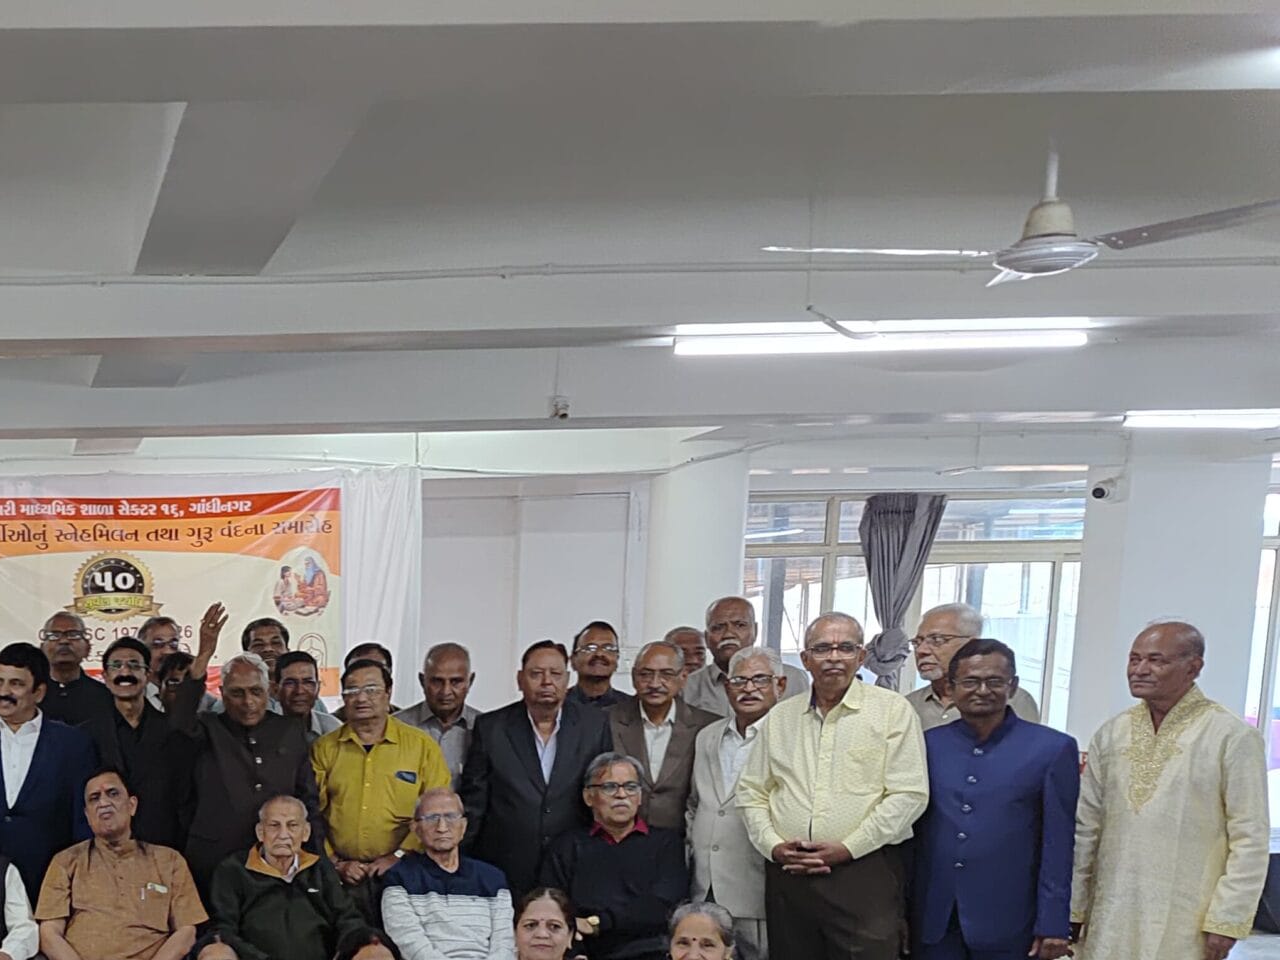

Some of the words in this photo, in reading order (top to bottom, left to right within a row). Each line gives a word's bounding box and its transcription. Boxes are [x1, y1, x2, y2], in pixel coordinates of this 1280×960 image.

[20, 500, 76, 516] માધ્યમિક
[80, 503, 114, 516] શાળા
[160, 503, 185, 518] ૧૬,
[188, 499, 252, 514] ગાંધીનગર
[54, 523, 140, 542] સ્નેહમિલન
[146, 527, 180, 542] તથા
[221, 520, 265, 538] વંદના
[272, 514, 333, 535] સમારોહ
[93, 571, 135, 592] ૫૦
[111, 626, 139, 640] 197
